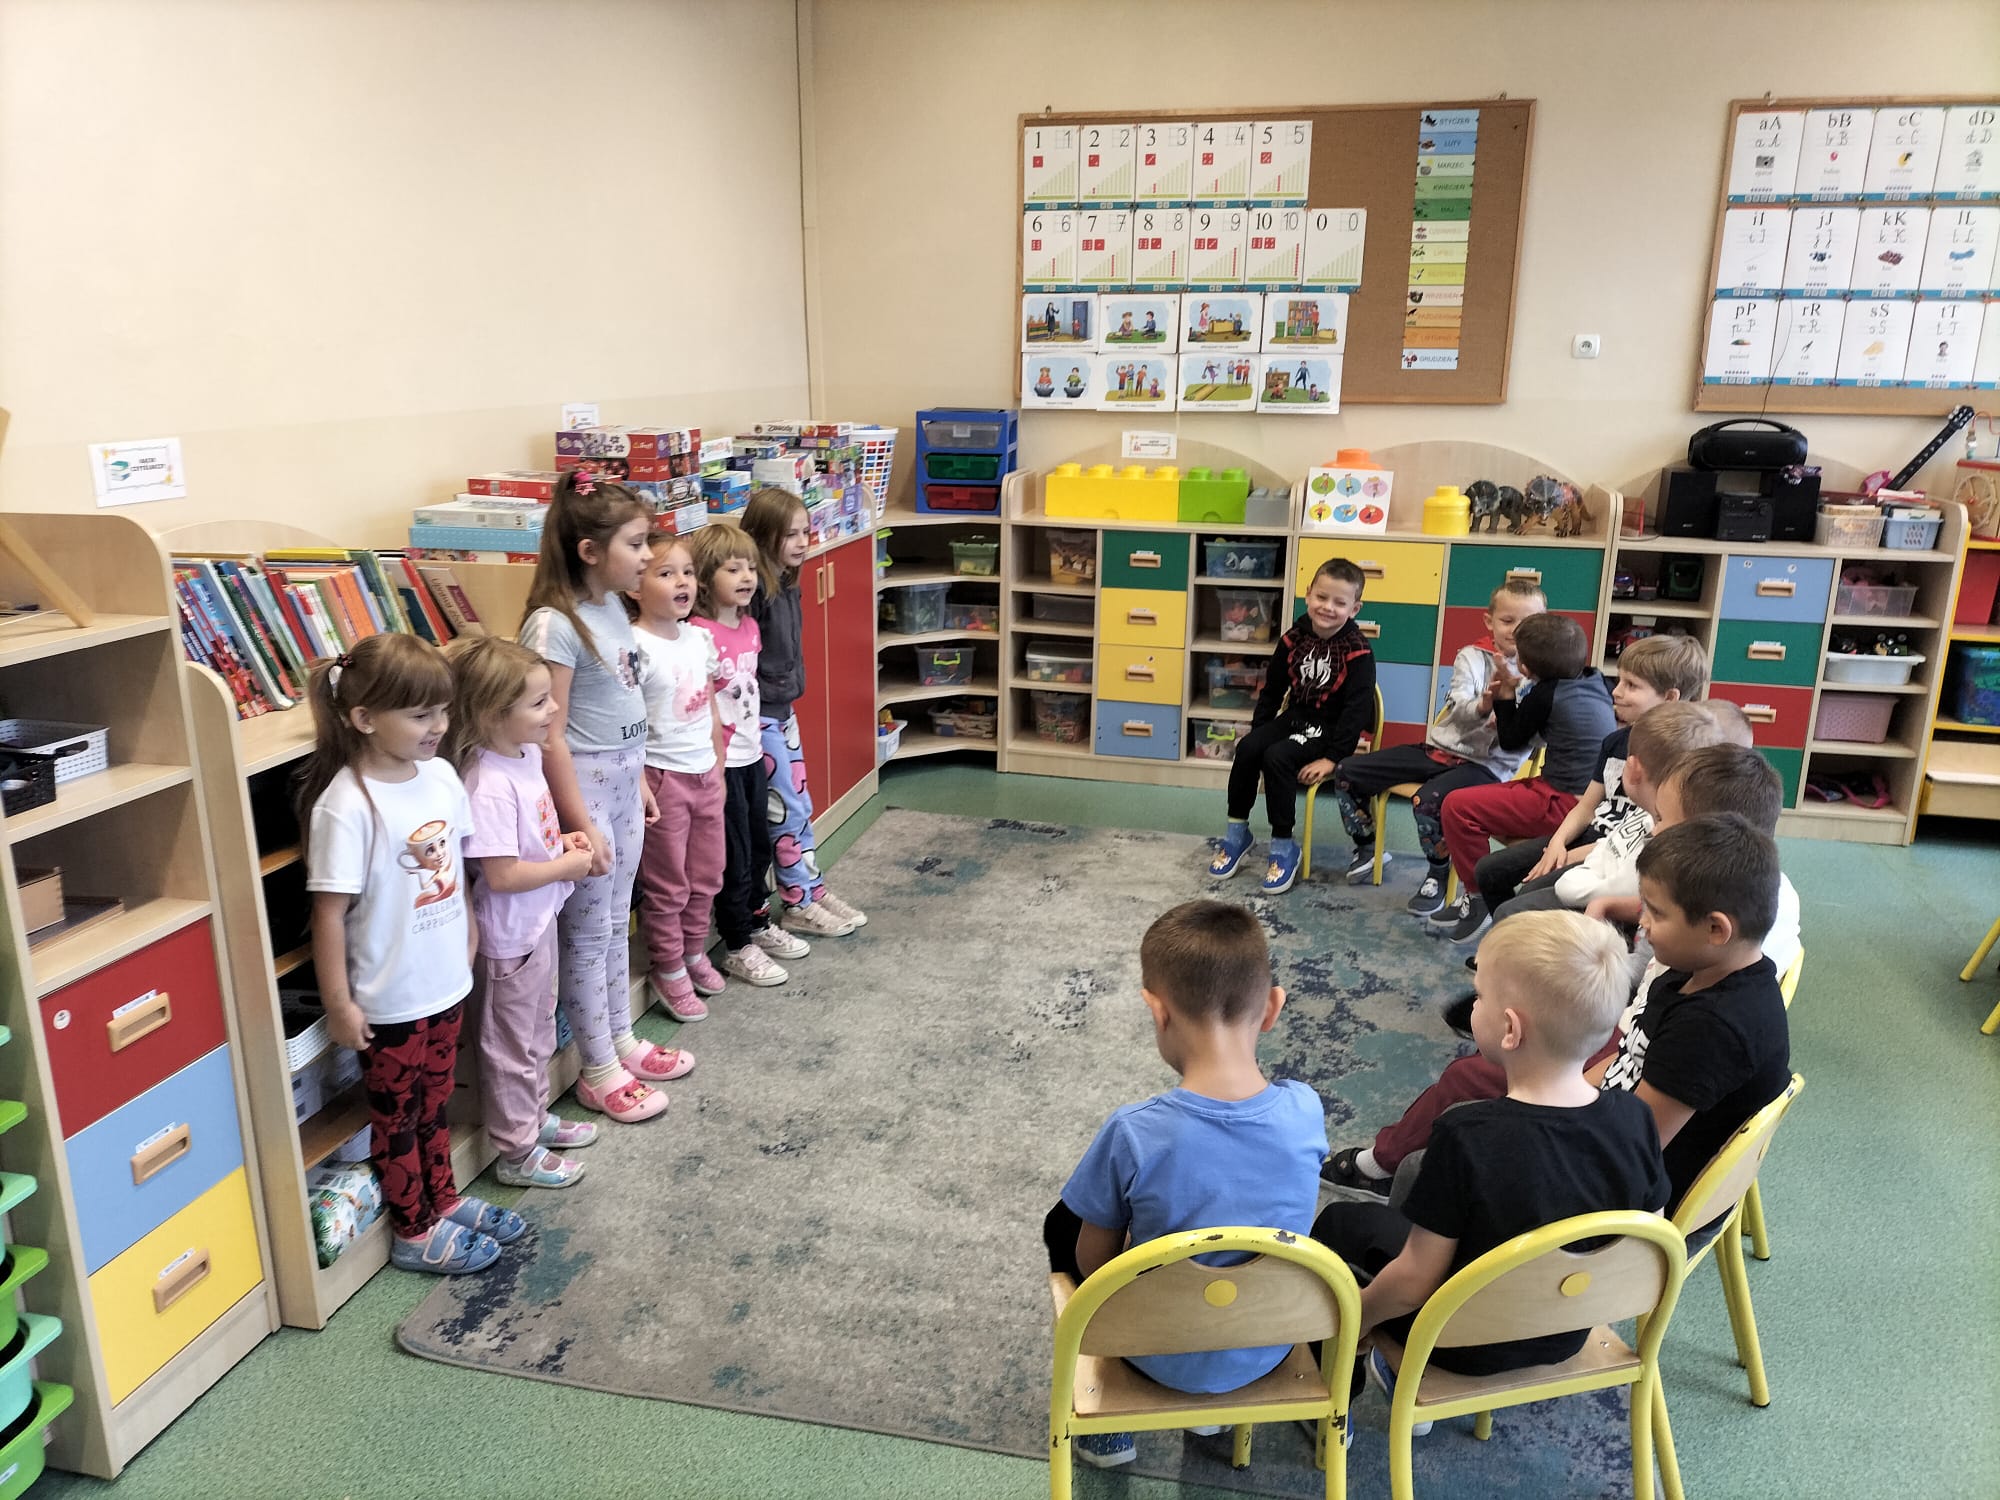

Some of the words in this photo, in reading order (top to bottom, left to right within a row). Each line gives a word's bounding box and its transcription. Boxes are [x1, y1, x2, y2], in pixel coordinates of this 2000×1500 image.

[1036, 132, 1040, 148] 1
[1064, 131, 1071, 146] 1
[1089, 132, 1100, 148] 2
[1120, 131, 1129, 147] 2
[1146, 130, 1156, 146] 3
[1177, 130, 1187, 146] 3
[1204, 129, 1214, 144] 4
[1234, 129, 1245, 144] 4
[1263, 128, 1272, 144] 5
[1294, 126, 1304, 144] 5
[1032, 215, 1042, 231] 6
[1061, 215, 1071, 231] 6
[1088, 216, 1097, 231] 7
[1117, 214, 1127, 230] 7
[1143, 214, 1153, 230] 8
[1174, 213, 1184, 230] 8
[1200, 213, 1210, 229] 9
[1230, 213, 1240, 230] 9
[1256, 213, 1272, 229] 10
[1283, 212, 1299, 229] 10
[1316, 214, 1327, 230] 0
[1348, 213, 1358, 230] 0
